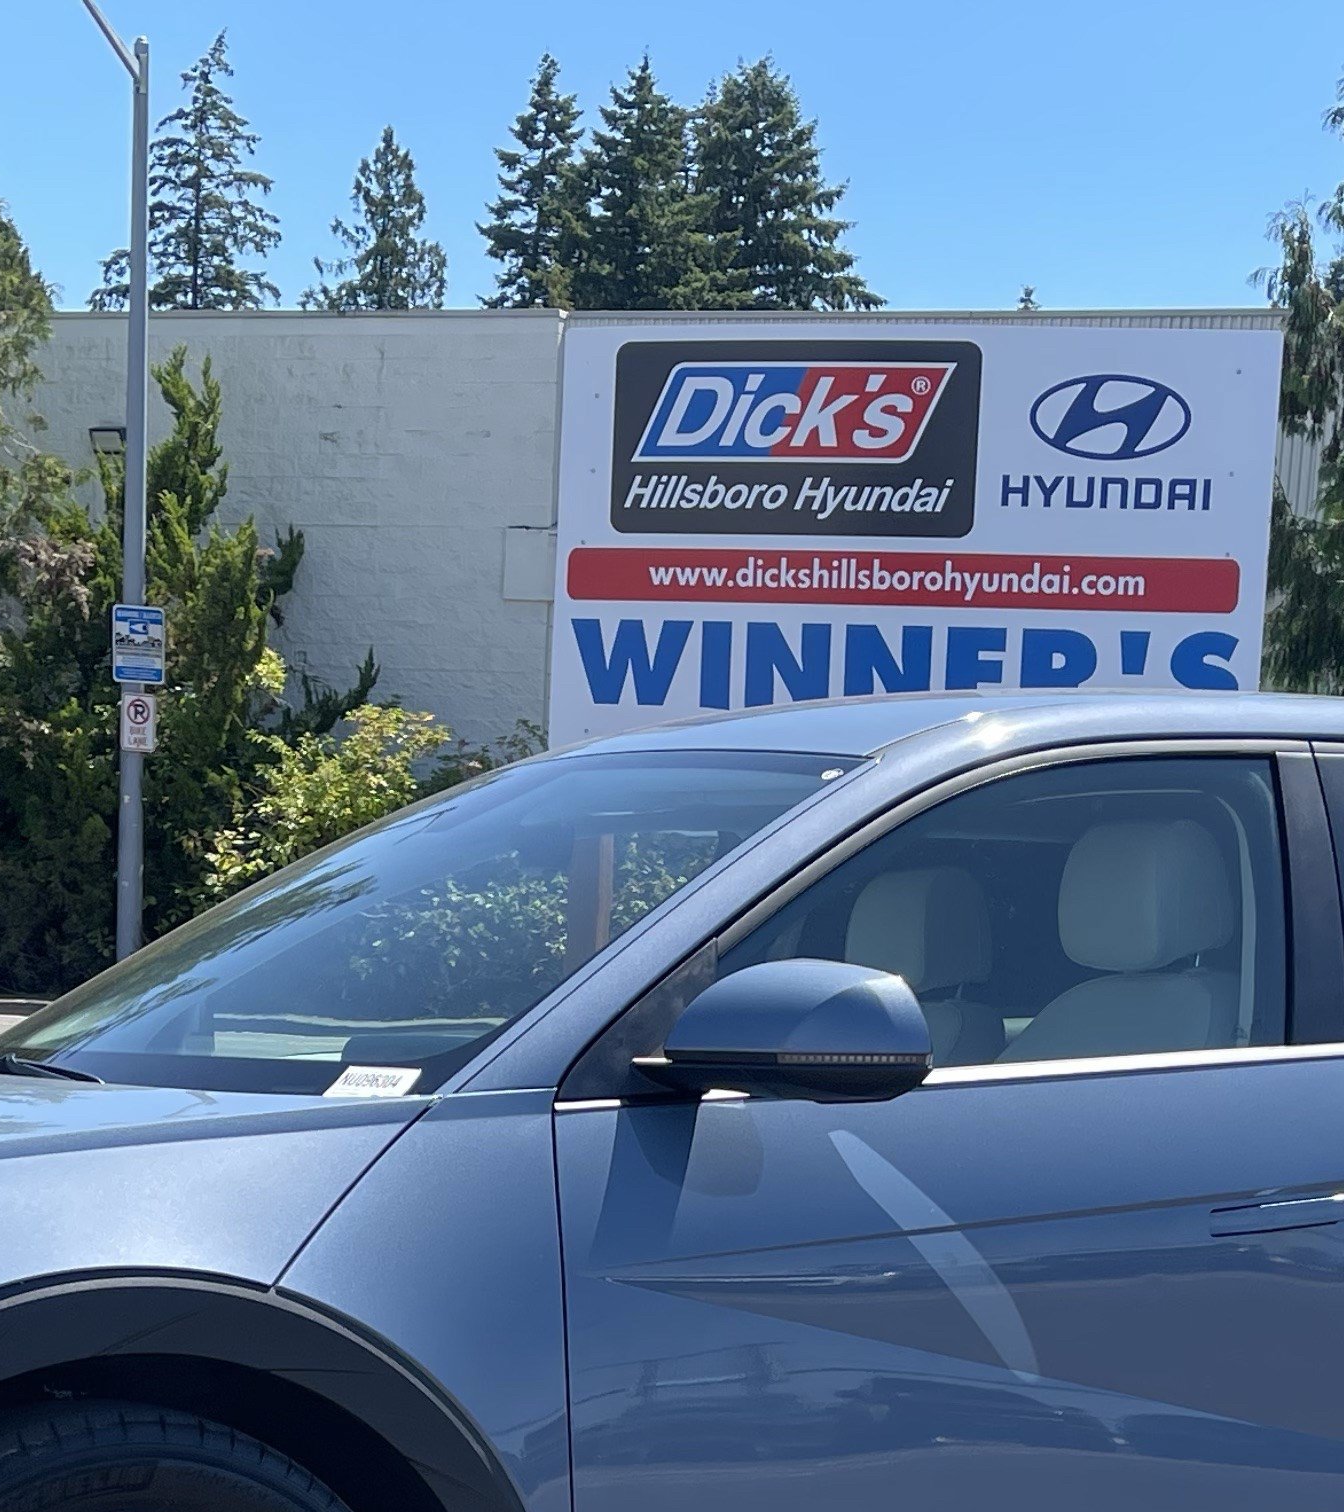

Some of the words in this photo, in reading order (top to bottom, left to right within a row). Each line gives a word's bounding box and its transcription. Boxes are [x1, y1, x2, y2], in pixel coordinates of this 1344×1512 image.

[624, 475, 787, 511] Hillsboro
[793, 477, 954, 519] Hyundai
[1001, 475, 1211, 511] HYUNDAI
[649, 559, 1146, 600] www.dickshillsborohyundai.com
